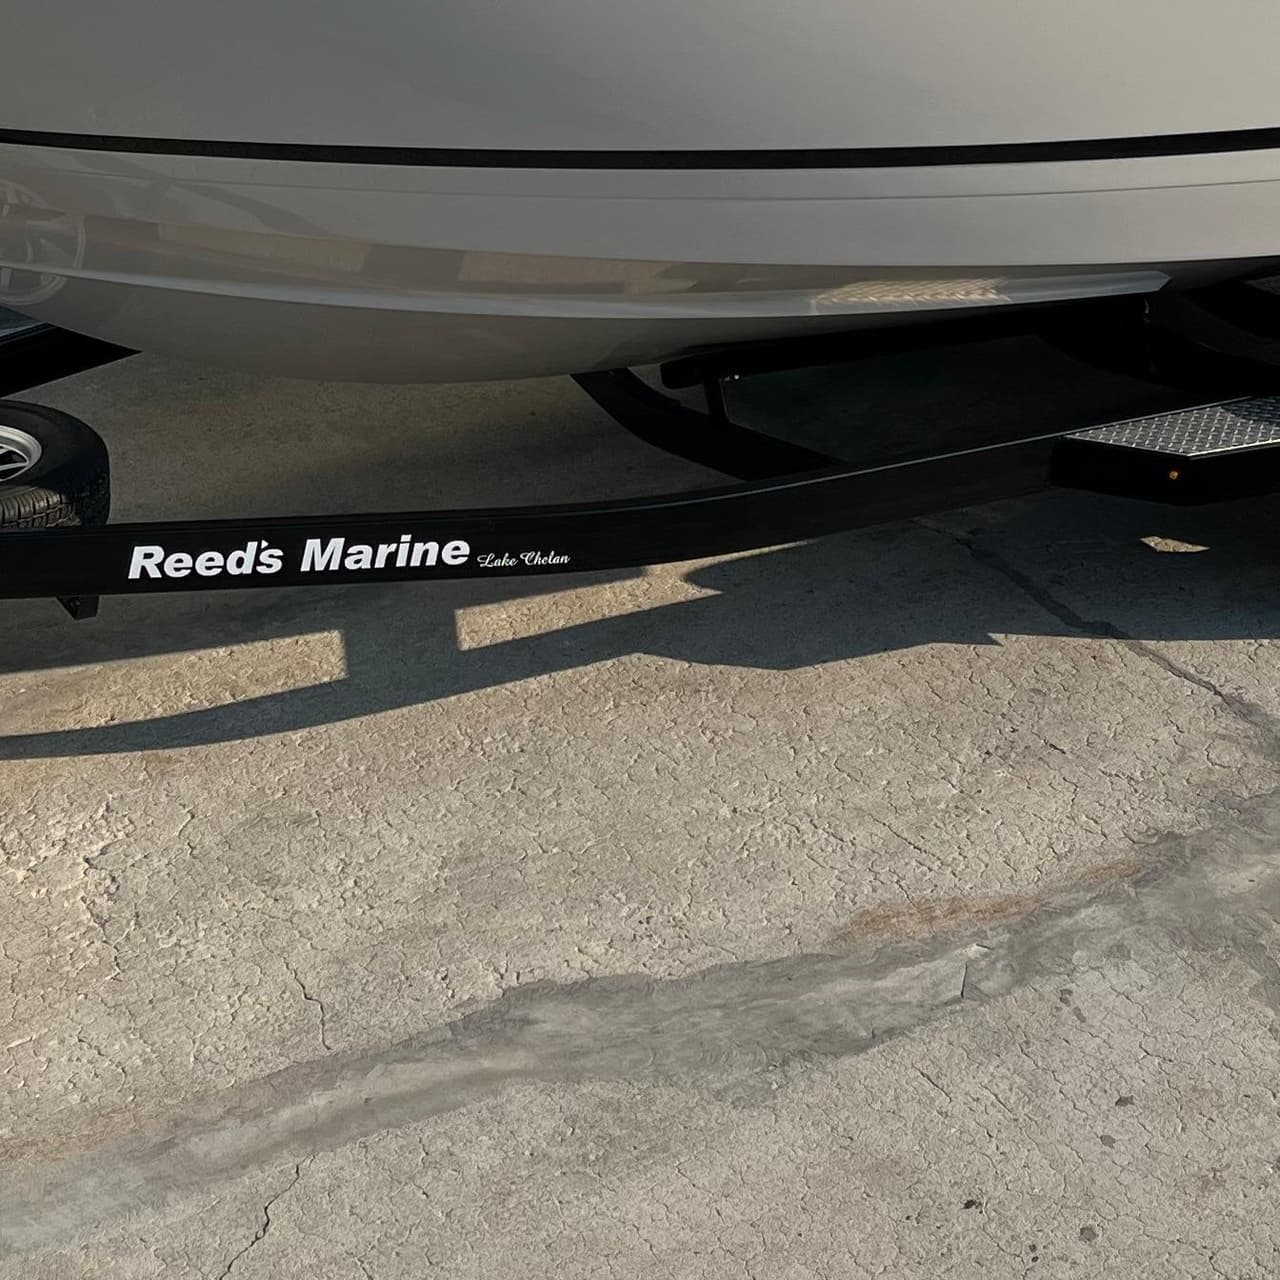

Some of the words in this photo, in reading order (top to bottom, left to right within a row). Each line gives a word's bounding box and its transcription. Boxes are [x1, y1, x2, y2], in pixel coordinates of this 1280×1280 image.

[127, 539, 283, 579] Reed's
[299, 533, 470, 573] Marine
[477, 552, 518, 568] Lake
[520, 550, 571, 566] Chelan
